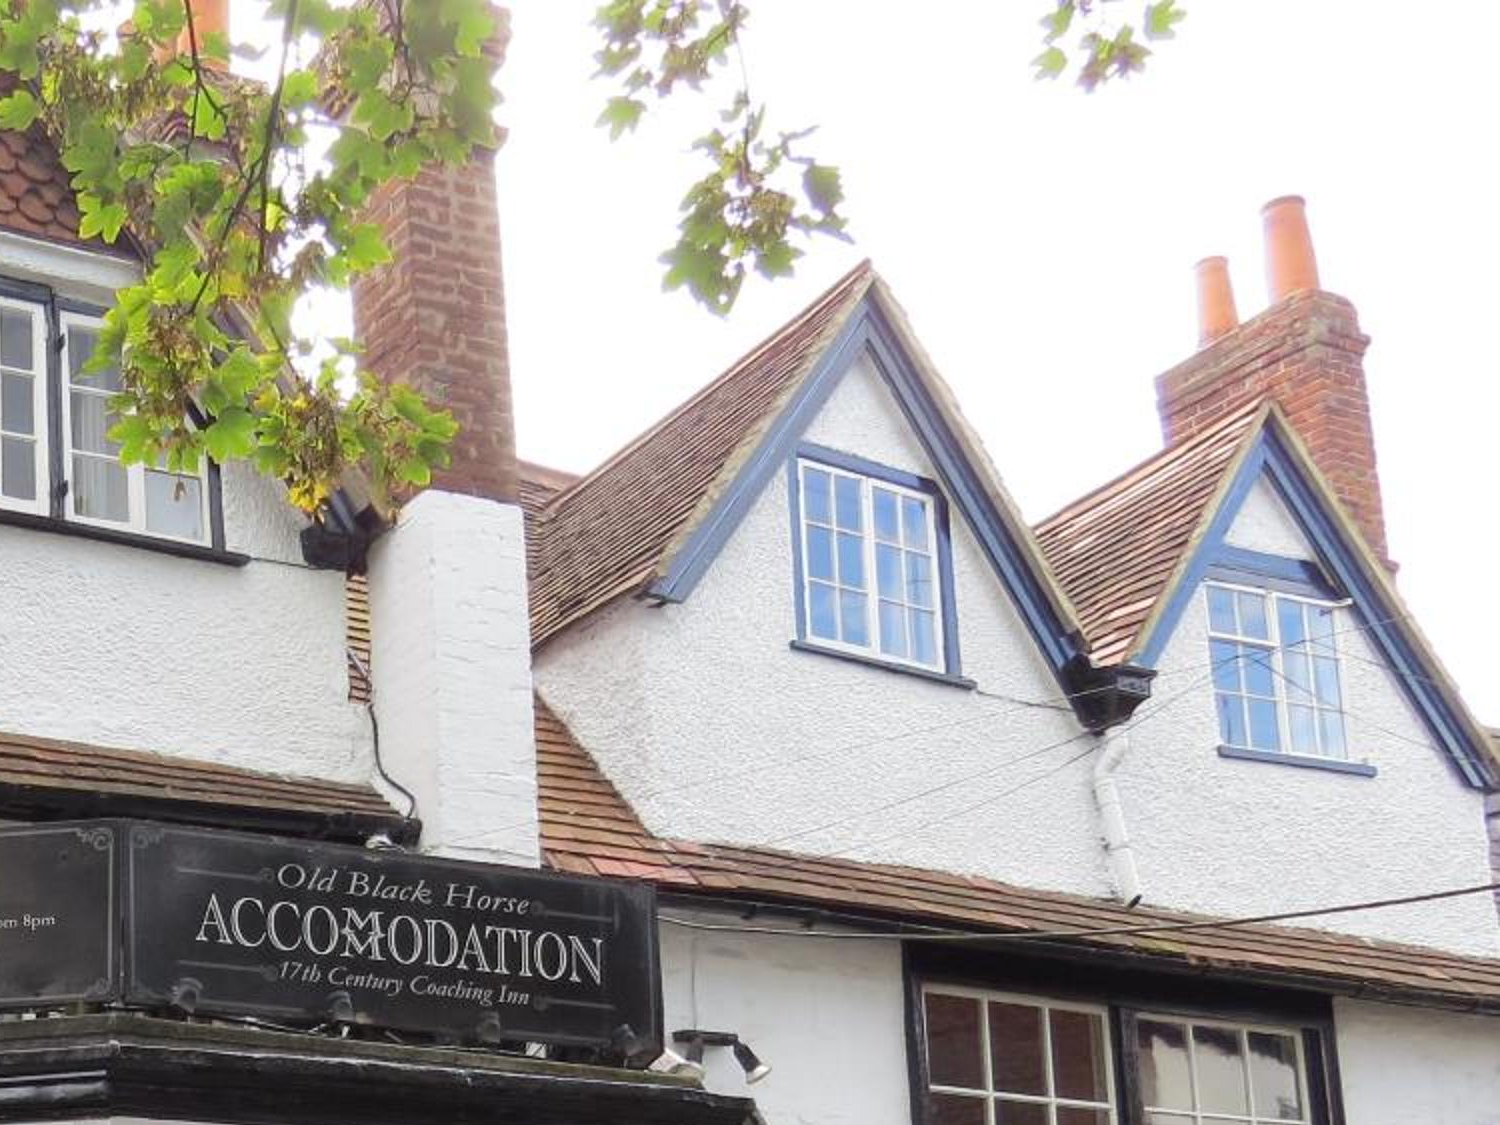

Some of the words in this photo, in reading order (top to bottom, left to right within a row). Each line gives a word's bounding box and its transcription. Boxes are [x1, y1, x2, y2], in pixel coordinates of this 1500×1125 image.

[276, 863, 335, 894] Old
[347, 870, 431, 904] Black
[445, 883, 530, 915] Horse
[23, 914, 56, 930] 8pm
[278, 960, 322, 984] 17th
[328, 966, 402, 996] Century
[410, 974, 493, 1007] Coaching
[497, 984, 529, 1006] Inn
